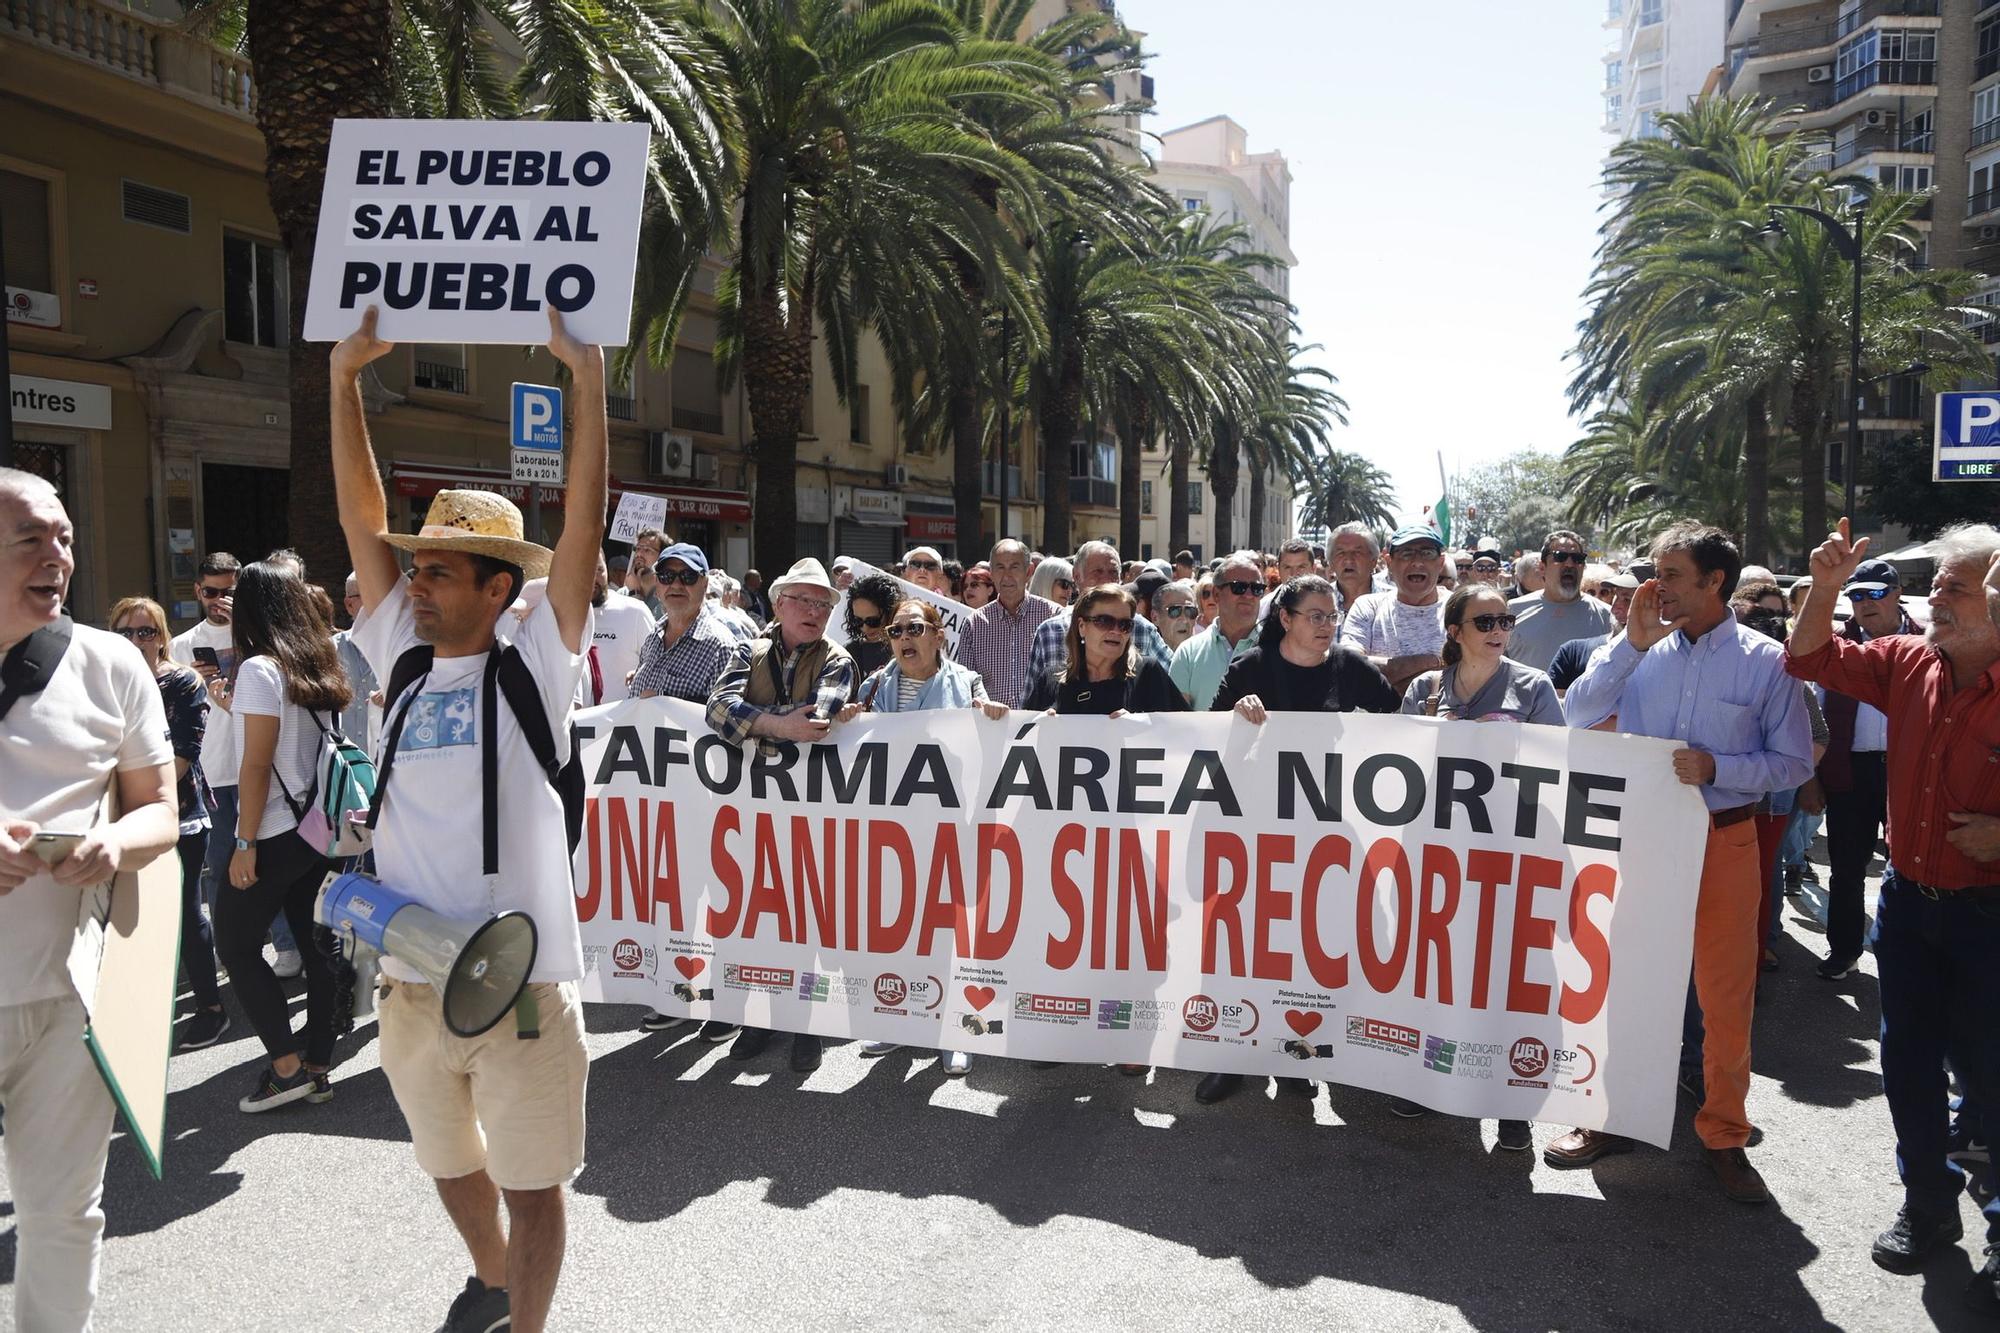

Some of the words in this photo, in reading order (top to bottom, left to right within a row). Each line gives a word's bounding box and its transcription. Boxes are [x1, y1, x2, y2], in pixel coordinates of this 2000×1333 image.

[356, 151, 405, 185] EL
[416, 151, 611, 187] PUEBLO
[352, 204, 521, 240] SALVA
[533, 206, 599, 242] AL
[340, 262, 596, 313] PUEBLO
[12, 388, 76, 413] ntres
[524, 392, 553, 441] P
[1959, 397, 2000, 443] P
[534, 433, 559, 444] MOTOS
[514, 454, 560, 467] Laborables
[516, 468, 525, 477] de
[527, 468, 532, 478] 8
[541, 469, 551, 479] 20
[1958, 463, 1993, 475] LIBRE
[501, 486, 525, 500] BAR
[679, 501, 697, 513] BAR
[698, 503, 721, 515] AQUA
[986, 723, 1243, 817] ÁREA
[1278, 751, 1627, 852] NORTE
[706, 804, 1024, 961] SANIDAD
[1046, 823, 1171, 972] SIN
[1201, 830, 1618, 1025] RECORTES
[616, 944, 639, 958] UGT
[742, 969, 781, 982] CCOO
[832, 975, 868, 988] SINDICATO
[878, 977, 903, 991] UGT
[1278, 989, 1304, 998] Plataforma
[1305, 992, 1316, 1000] Zona
[1034, 998, 1076, 1012] CCOO
[1134, 1000, 1176, 1011] SINDICATO
[1187, 1000, 1214, 1014] UGT
[1134, 1009, 1166, 1020] MÉDICO
[1368, 1023, 1409, 1042] CCOO
[1460, 1041, 1504, 1056] SINDICATO
[1514, 1042, 1544, 1060] UGT
[1458, 1051, 1492, 1068] MÉDICO
[1457, 1067, 1495, 1080] MÁLAGA
